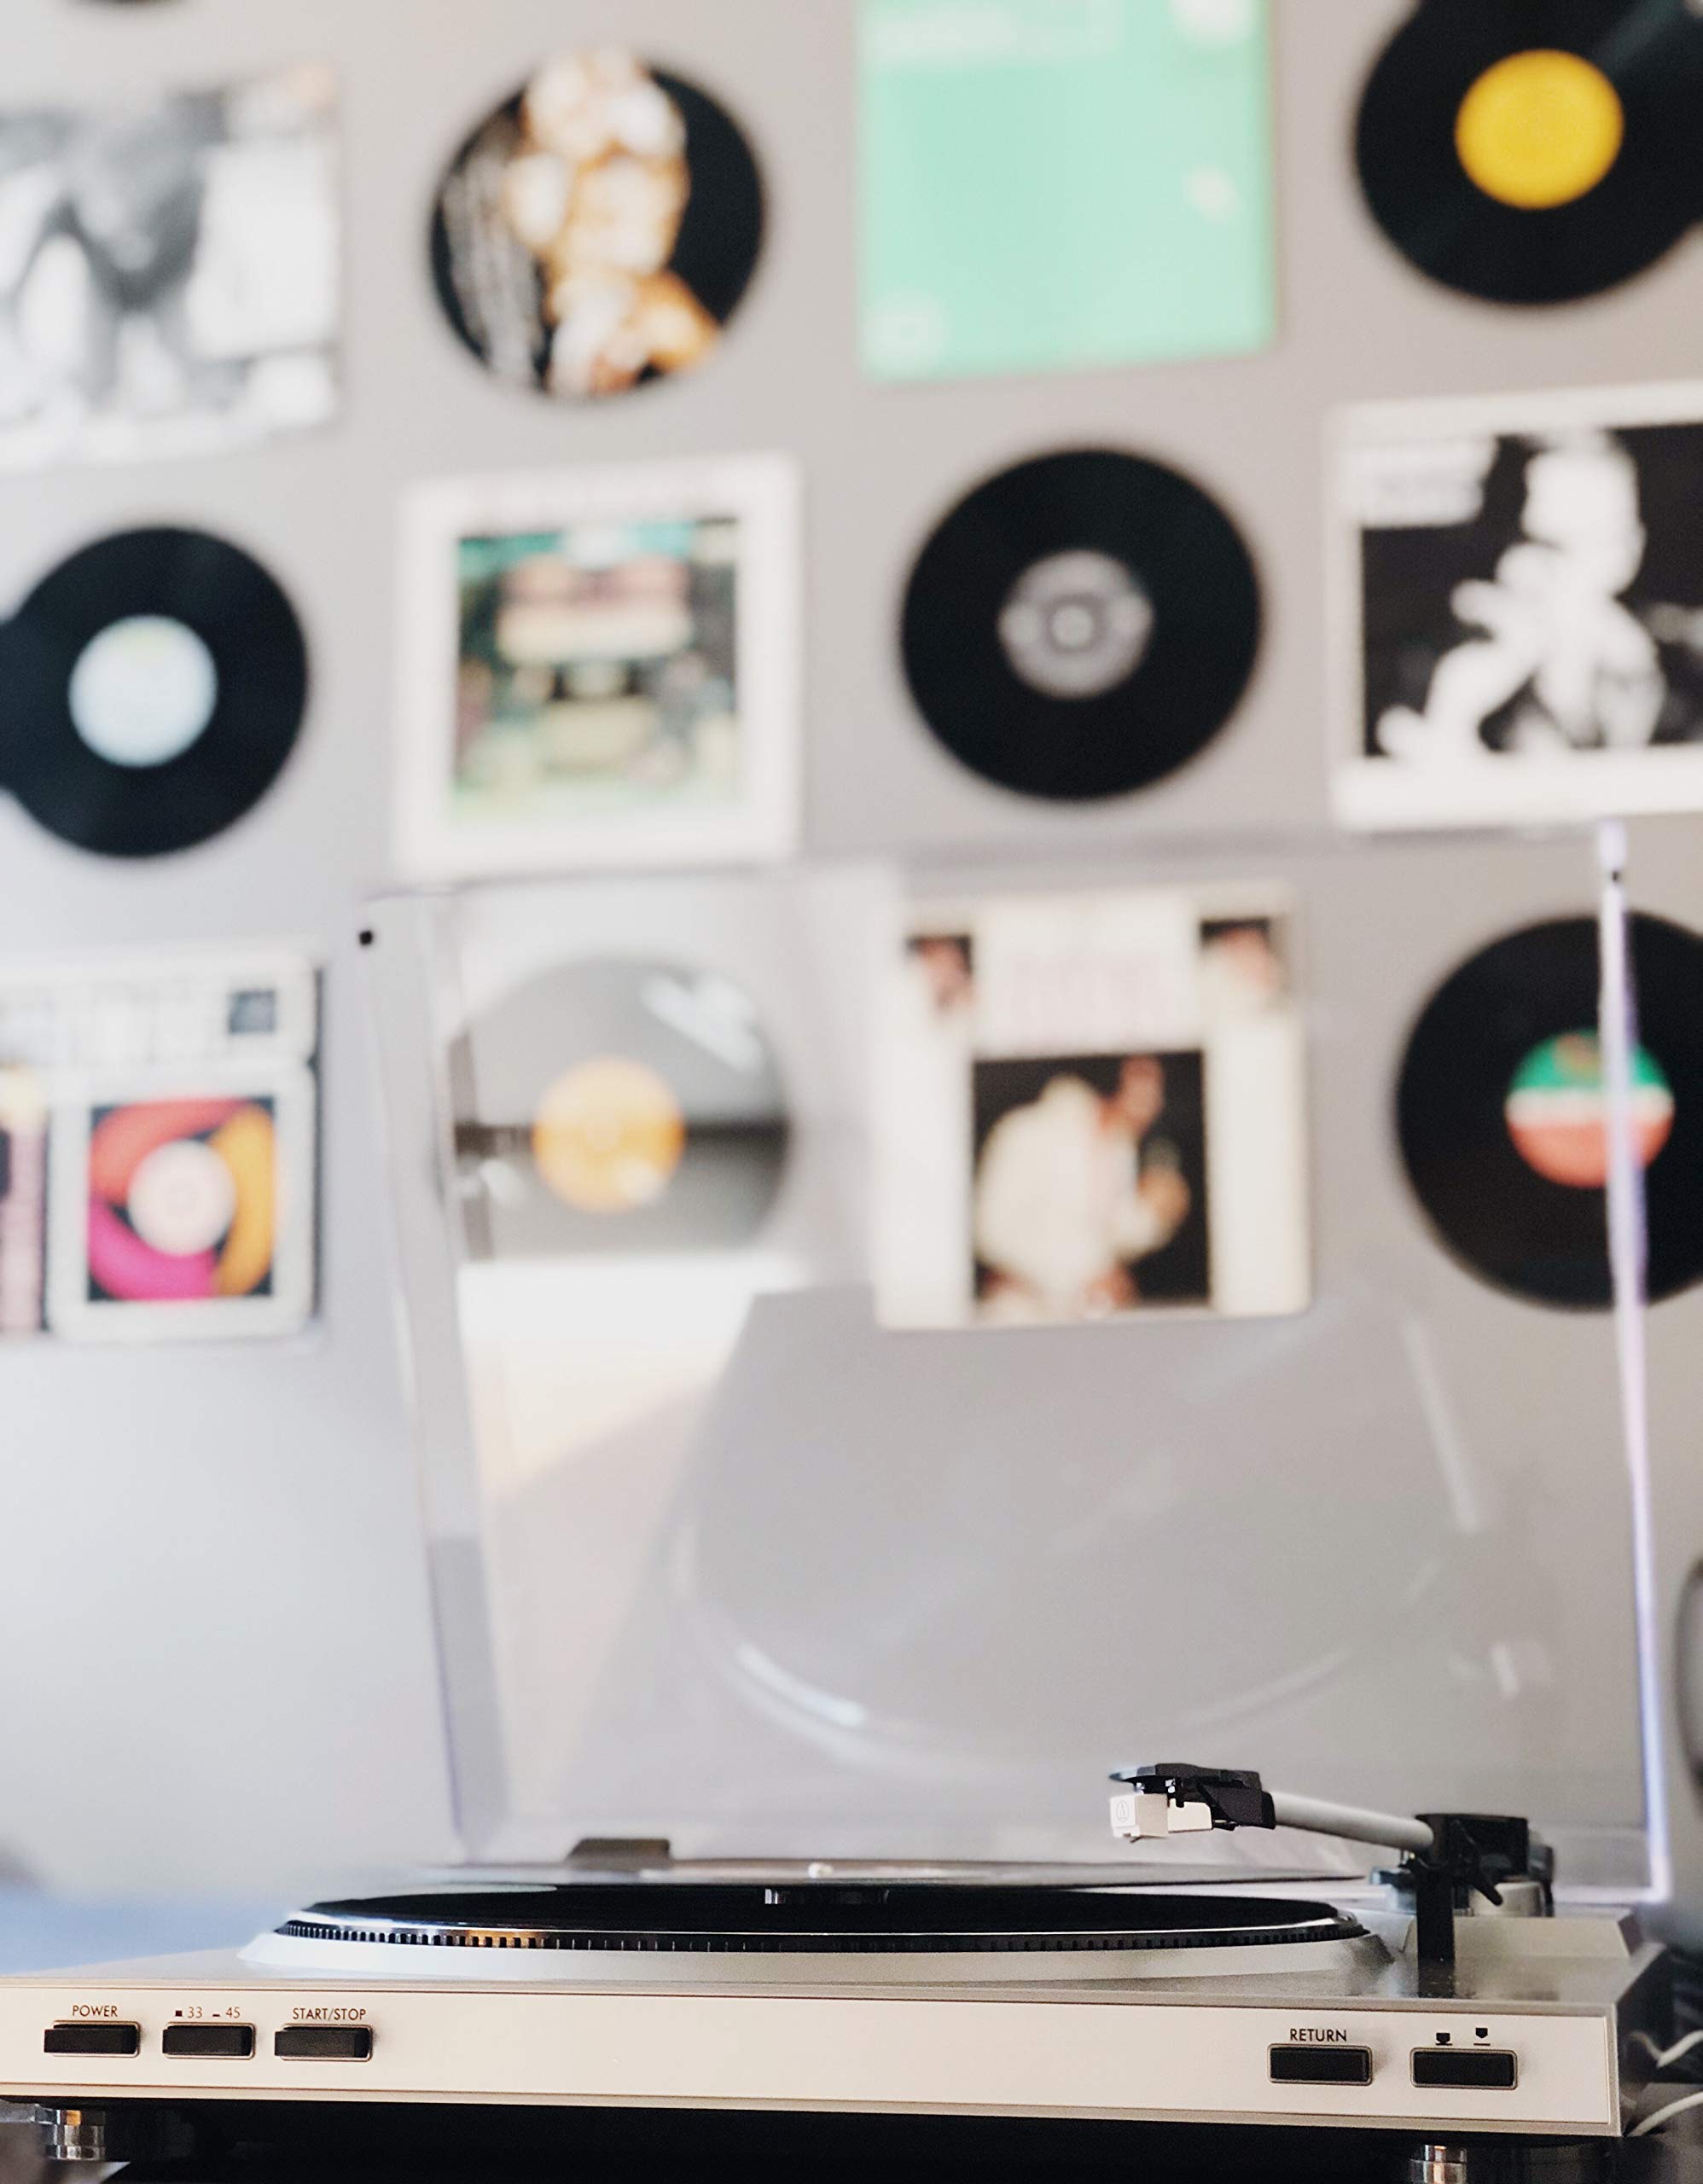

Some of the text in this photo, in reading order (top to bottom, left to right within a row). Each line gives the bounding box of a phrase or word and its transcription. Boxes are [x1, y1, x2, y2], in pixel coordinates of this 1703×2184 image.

[72, 2005, 118, 2018] POWER
[187, 2007, 241, 2018] 33 45
[292, 2007, 367, 2021] START/STOP
[1289, 2028, 1347, 2043] RETURN
